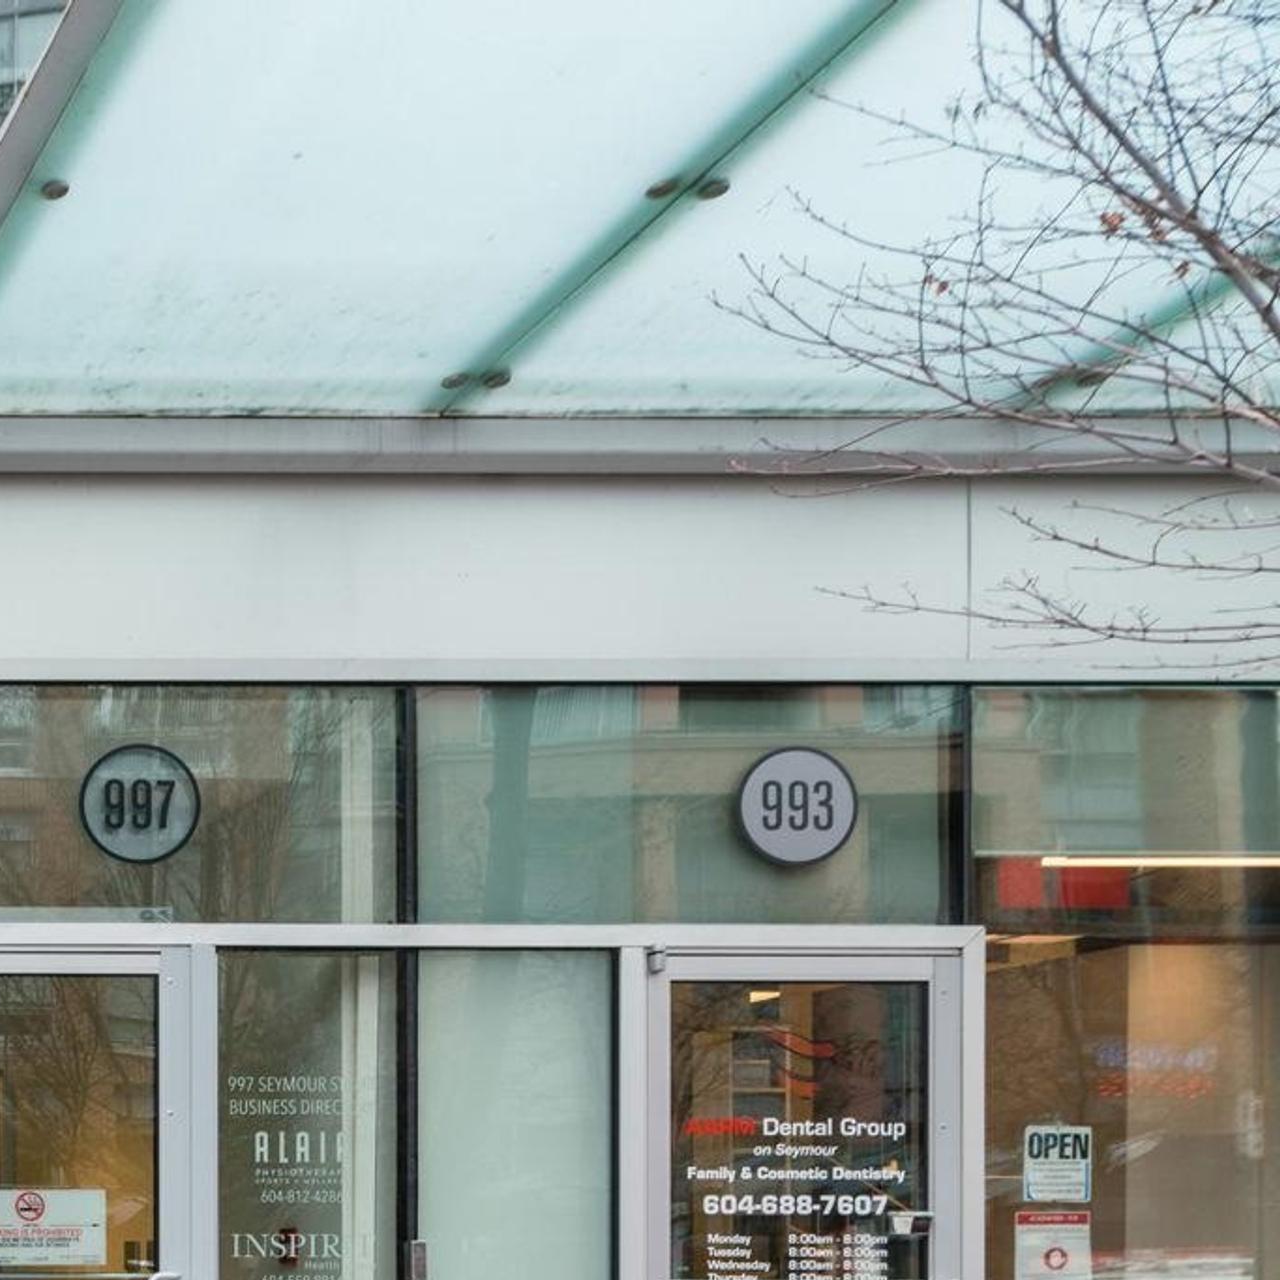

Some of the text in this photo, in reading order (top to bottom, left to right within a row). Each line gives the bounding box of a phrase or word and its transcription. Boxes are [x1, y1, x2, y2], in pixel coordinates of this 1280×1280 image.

[104, 778, 175, 829] 997
[762, 780, 834, 831] 993
[227, 1076, 254, 1092] 997
[258, 1076, 328, 1092] SEYMOUR
[229, 1099, 297, 1115] BUSINESS
[762, 1117, 833, 1136] Dental
[840, 1117, 907, 1140] Group
[753, 1143, 838, 1159] on Seymour
[1027, 1132, 1090, 1160] OPEN
[687, 1166, 905, 1183] Family & Cosmetic Dentistry
[702, 1195, 889, 1215] 604-688-7607
[706, 1234, 752, 1245] Monday
[706, 1247, 752, 1258] Tuesday
[706, 1260, 771, 1272] Wednesday
